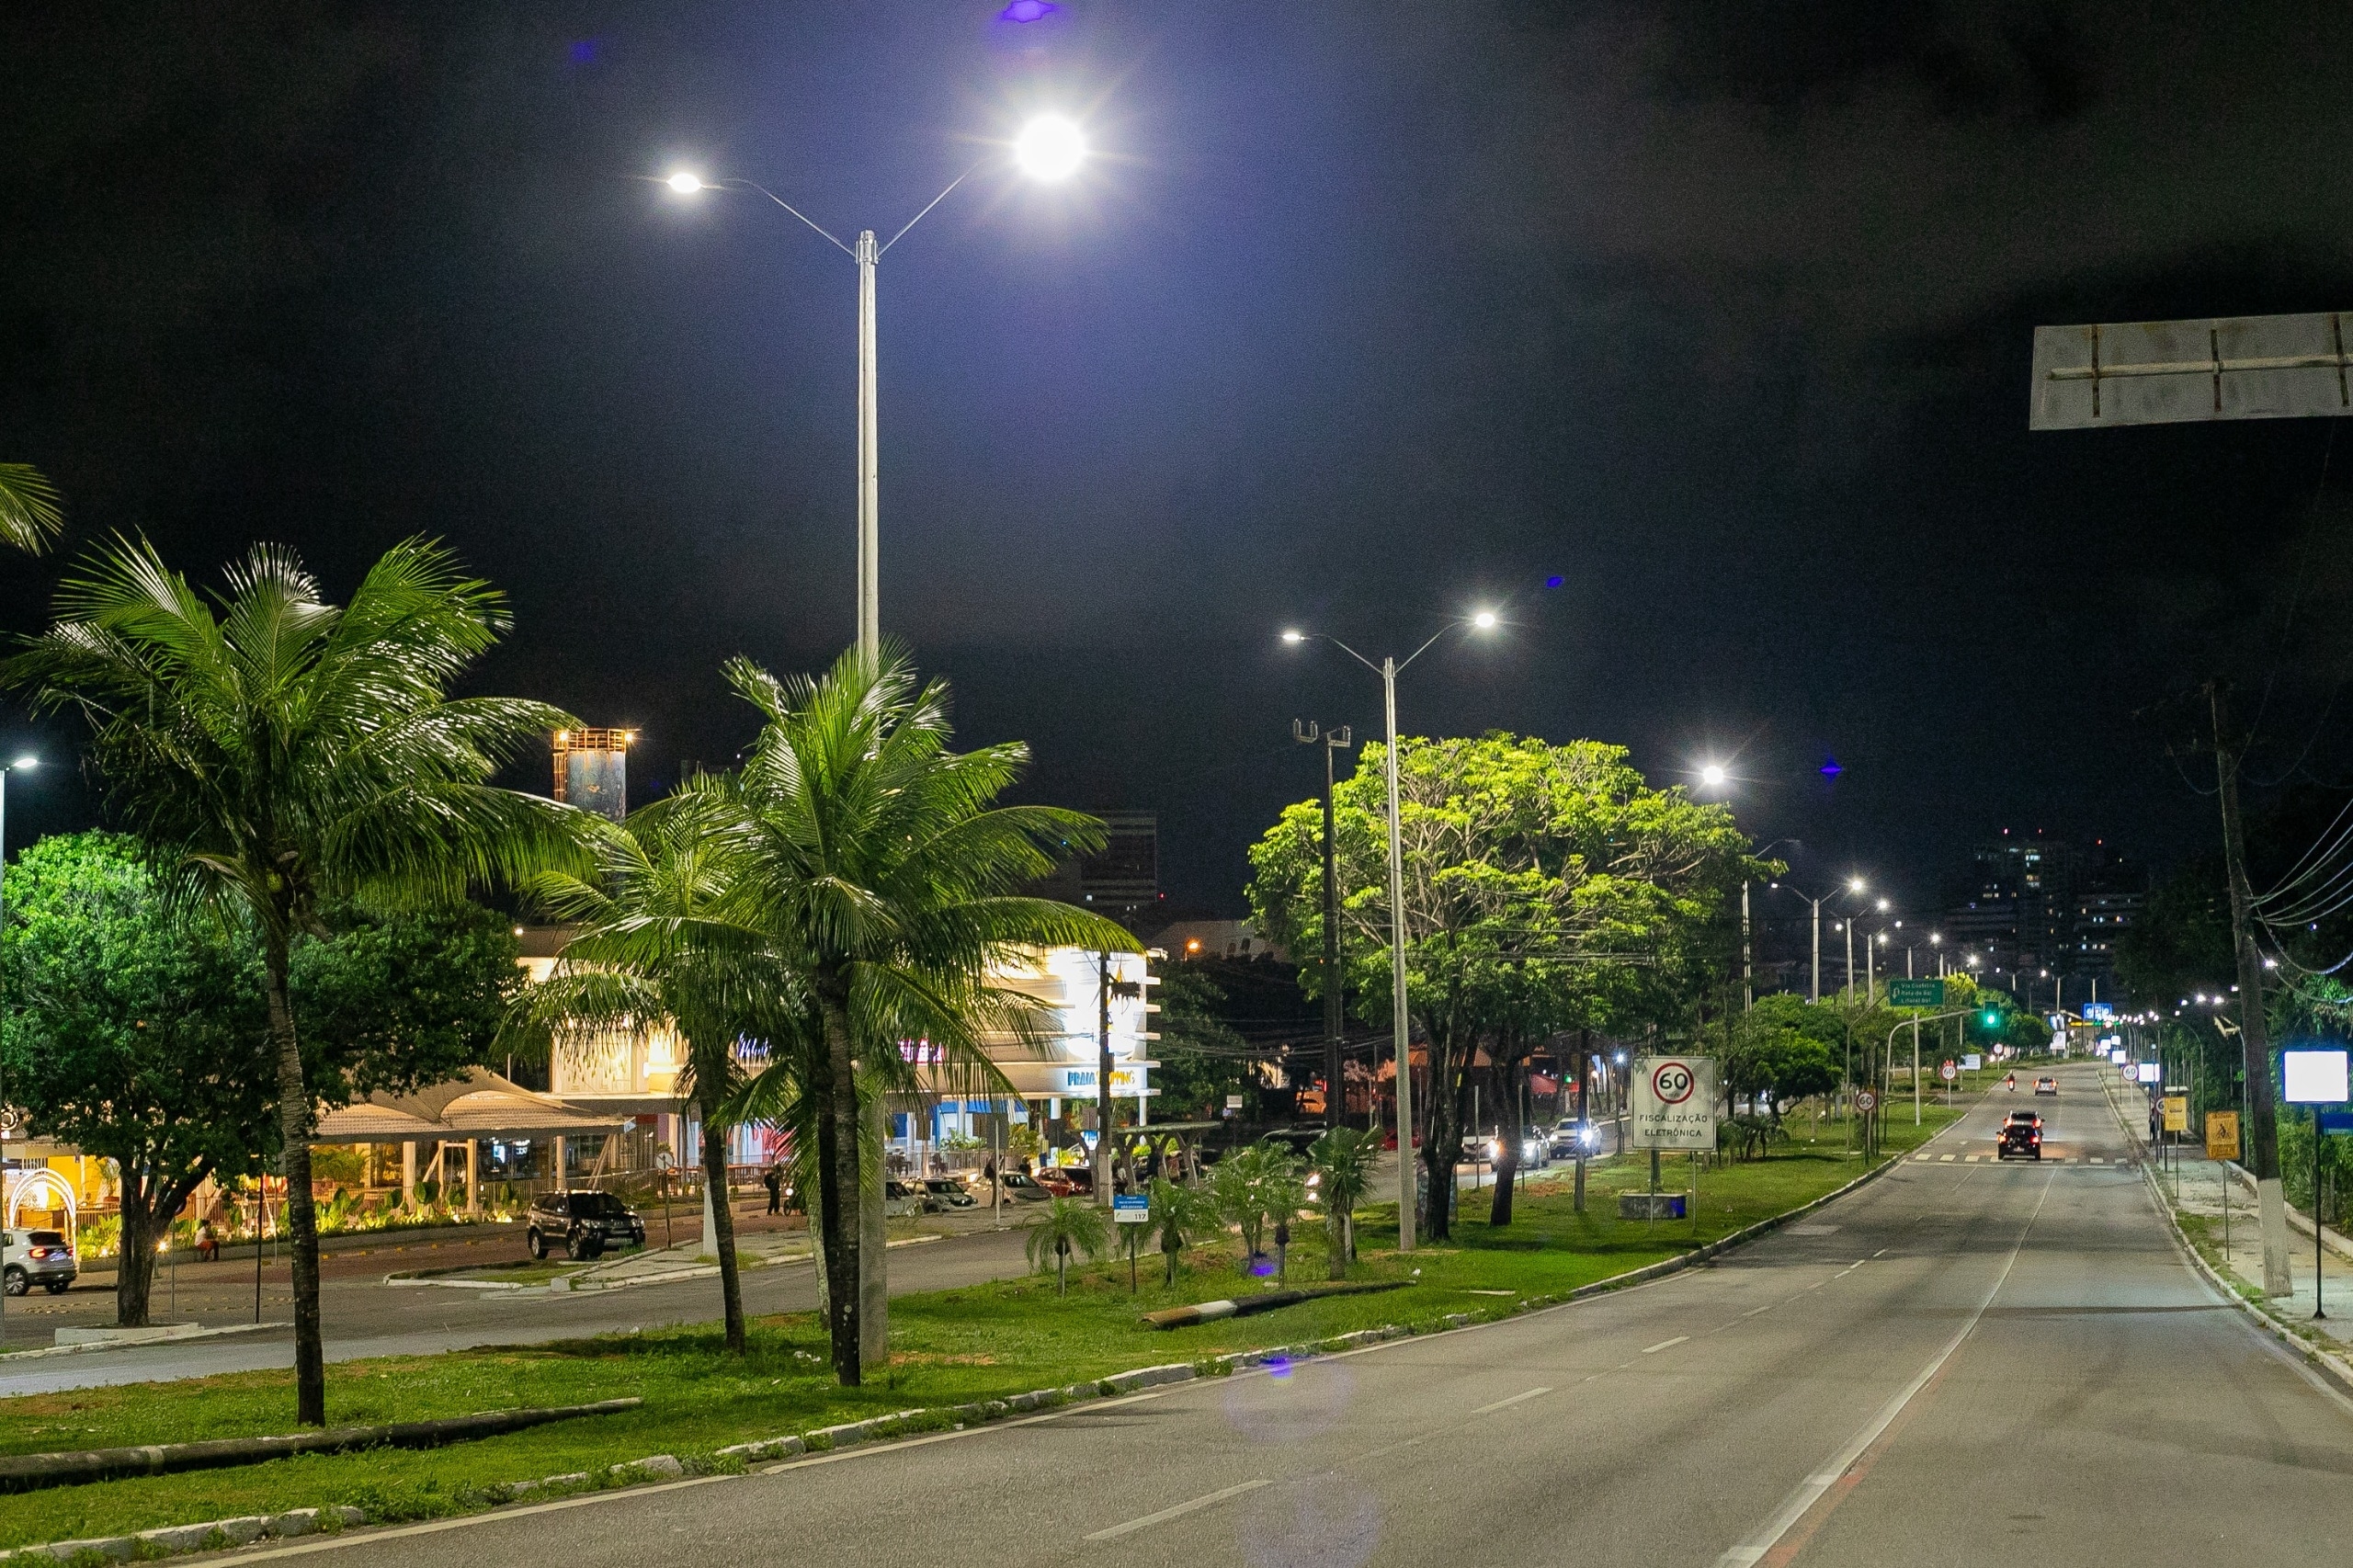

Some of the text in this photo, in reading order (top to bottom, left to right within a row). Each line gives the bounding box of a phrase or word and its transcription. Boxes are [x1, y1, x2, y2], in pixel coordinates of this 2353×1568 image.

[1068, 1071, 1135, 1085] PRAIA OPPING
[1659, 1073, 1688, 1090] 60
[1859, 1096, 1873, 1106] 60
[1639, 1113, 1708, 1124] FISCALIZAÇÃO
[1644, 1128, 1702, 1137] ELETRÔNICA
